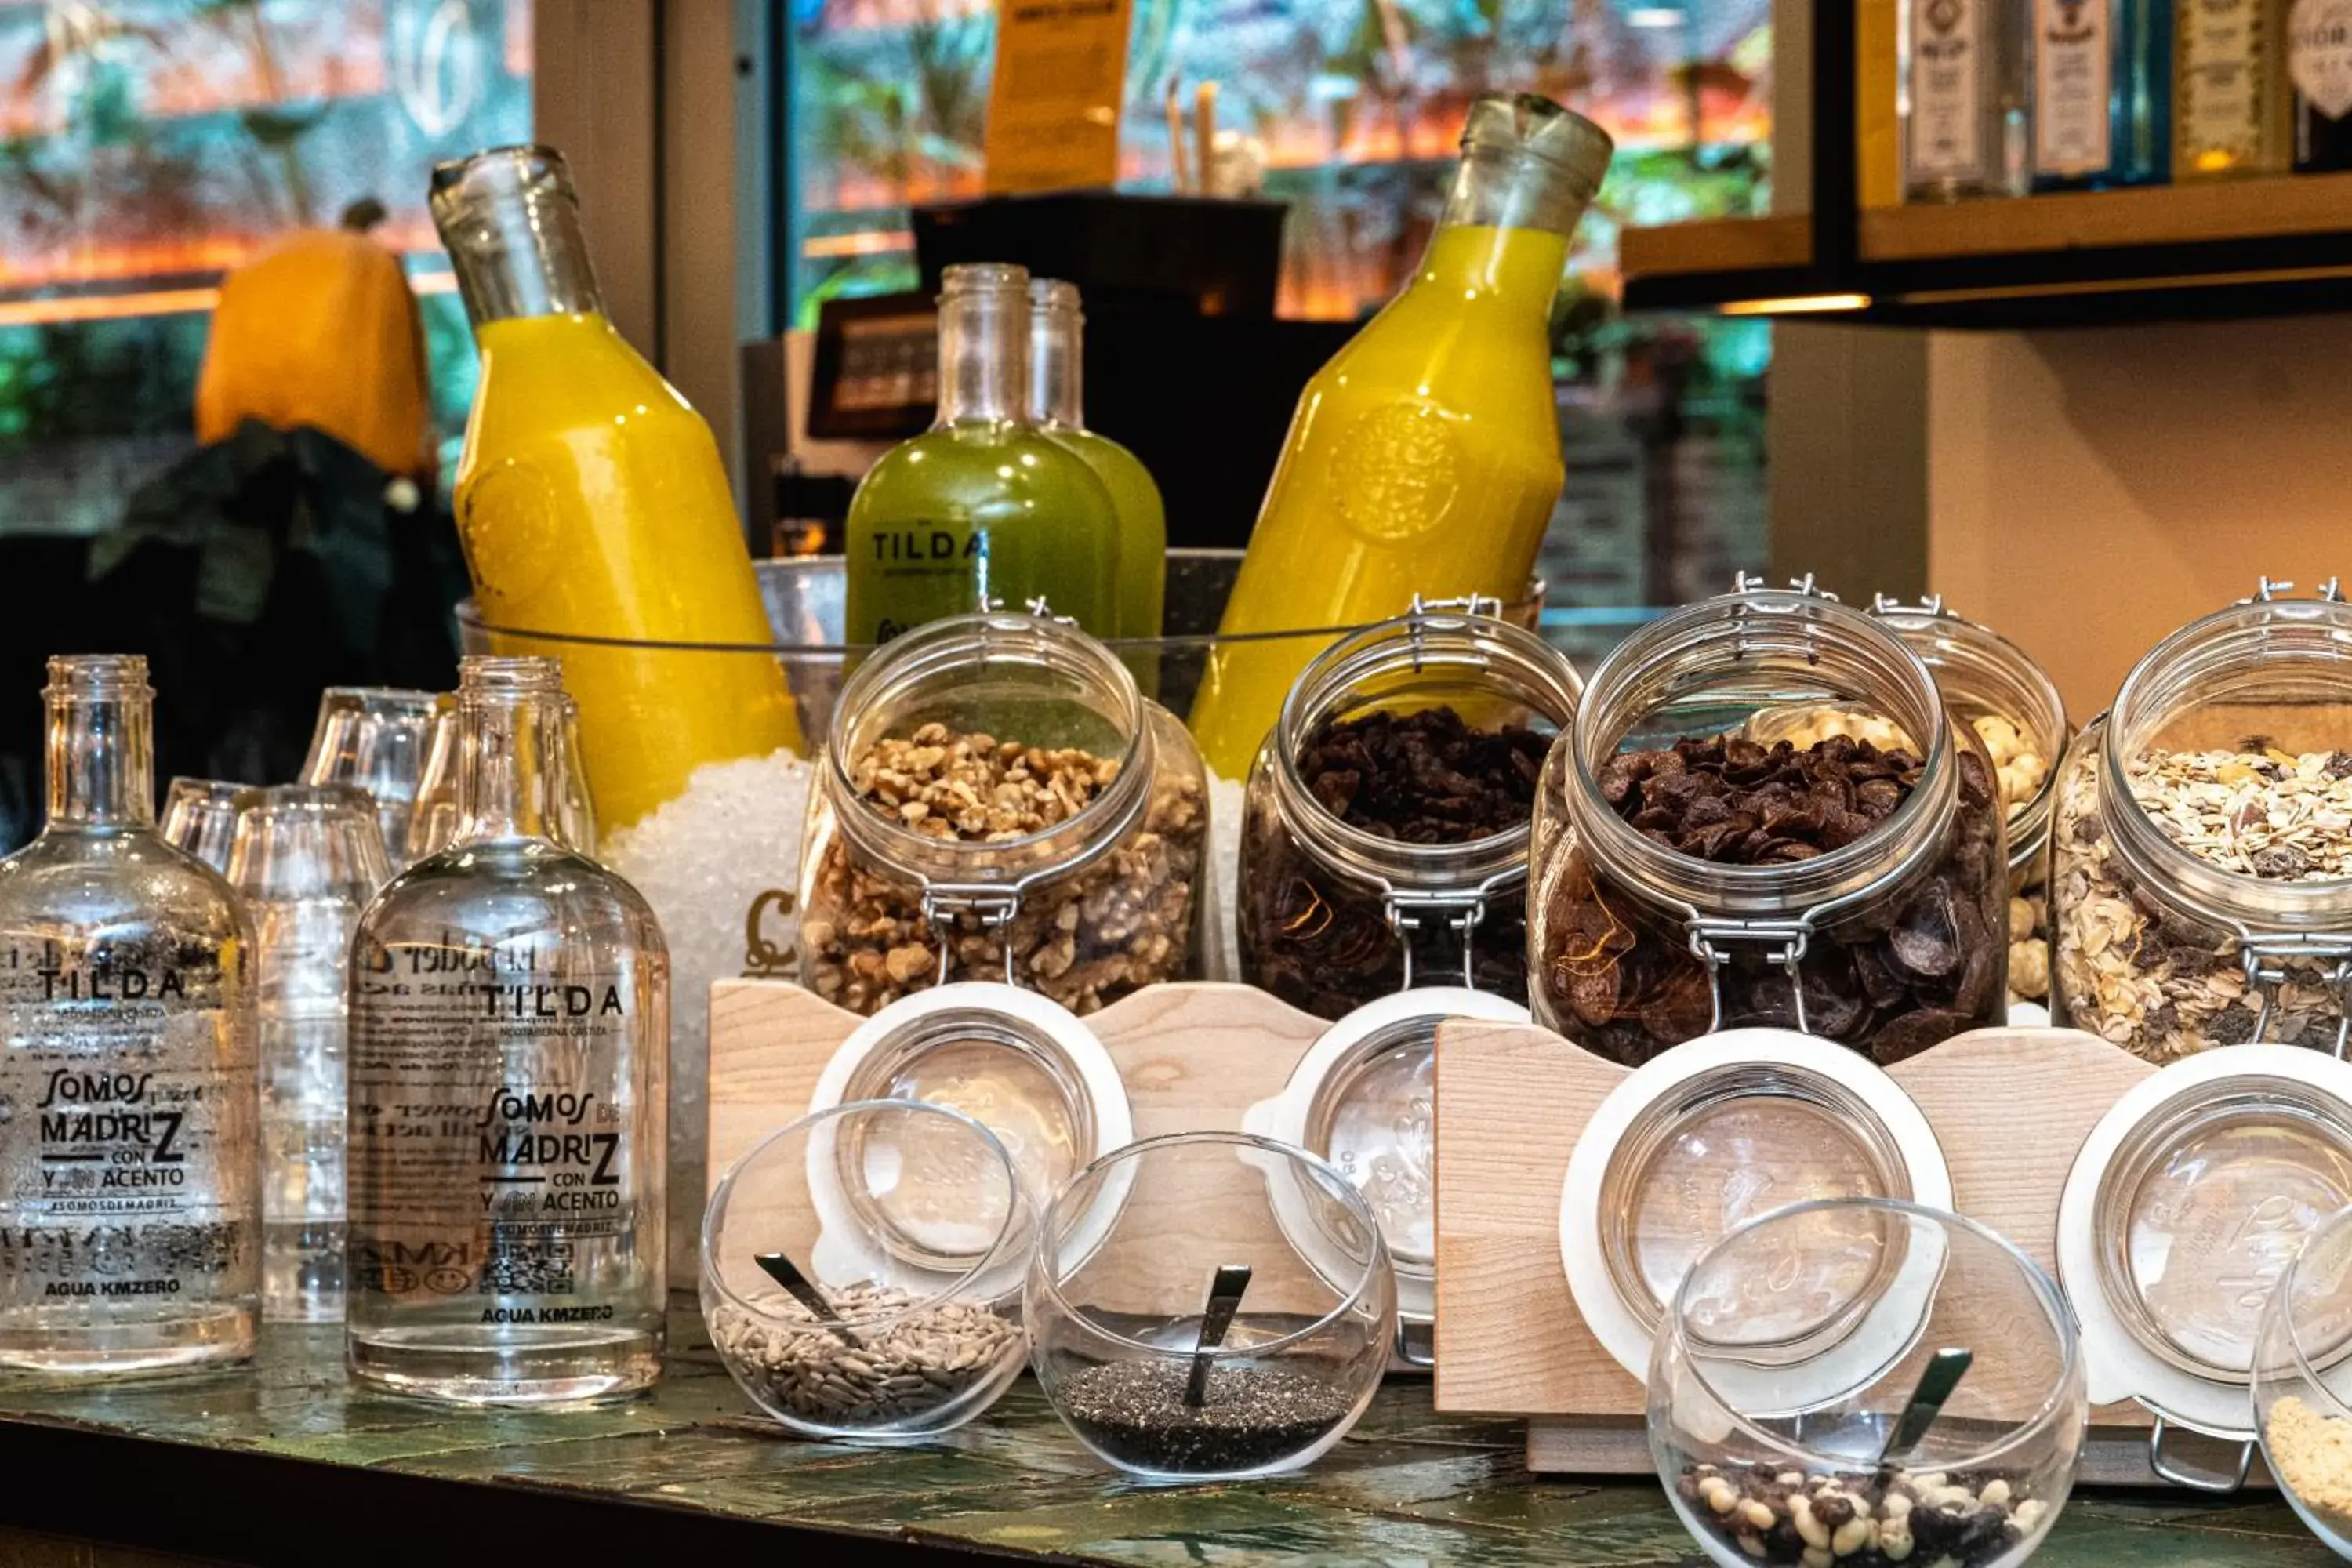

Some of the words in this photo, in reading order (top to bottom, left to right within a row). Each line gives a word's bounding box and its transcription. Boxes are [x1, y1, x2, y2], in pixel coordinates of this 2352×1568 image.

[873, 531, 989, 560] TILDA
[38, 970, 183, 999] TILDA
[479, 985, 623, 1016] TILDA
[37, 1069, 153, 1108] SOMOS
[475, 1087, 594, 1127] SOMOS
[41, 1112, 184, 1162] MADRIZ
[111, 1150, 146, 1164] CON
[480, 1134, 620, 1185] MADRIZ
[42, 1170, 56, 1188] Y
[101, 1168, 184, 1188] ACENTO
[553, 1173, 586, 1187] CON
[481, 1192, 495, 1210] Y
[543, 1190, 619, 1210] ACENTO
[45, 1282, 96, 1296] AGUA
[100, 1279, 180, 1296] KMZERO
[481, 1308, 535, 1323] AGUA
[539, 1305, 614, 1323] KMZERO
